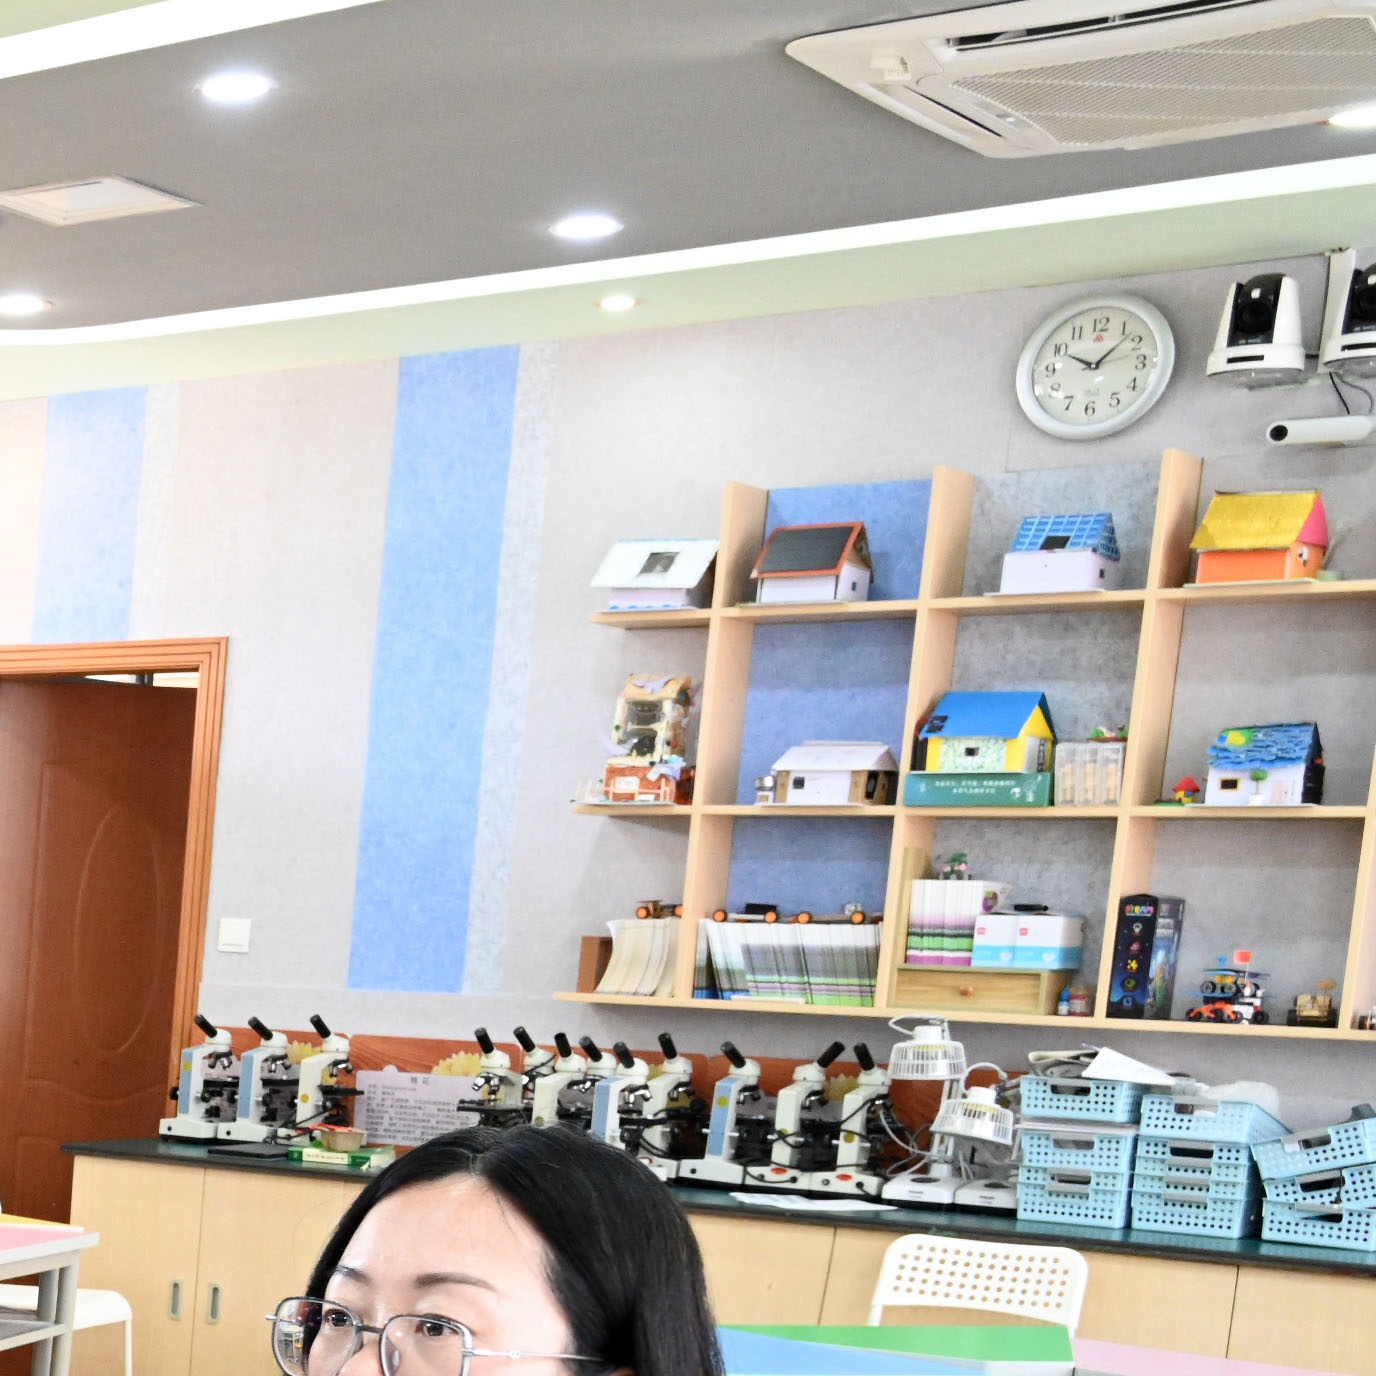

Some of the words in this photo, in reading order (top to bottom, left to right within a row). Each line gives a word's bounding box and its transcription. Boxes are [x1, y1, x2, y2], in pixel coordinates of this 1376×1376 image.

[1071, 325, 1083, 340] 11
[1092, 316, 1110, 333] 12
[1121, 321, 1127, 336] 1
[1054, 342, 1068, 357] 10
[1131, 335, 1143, 351] 2
[1045, 362, 1056, 378] 9
[1135, 354, 1147, 370] 3
[1126, 376, 1138, 392] 4
[1064, 395, 1074, 411] 7
[1109, 392, 1121, 408] 5
[1084, 401, 1096, 416] 6
